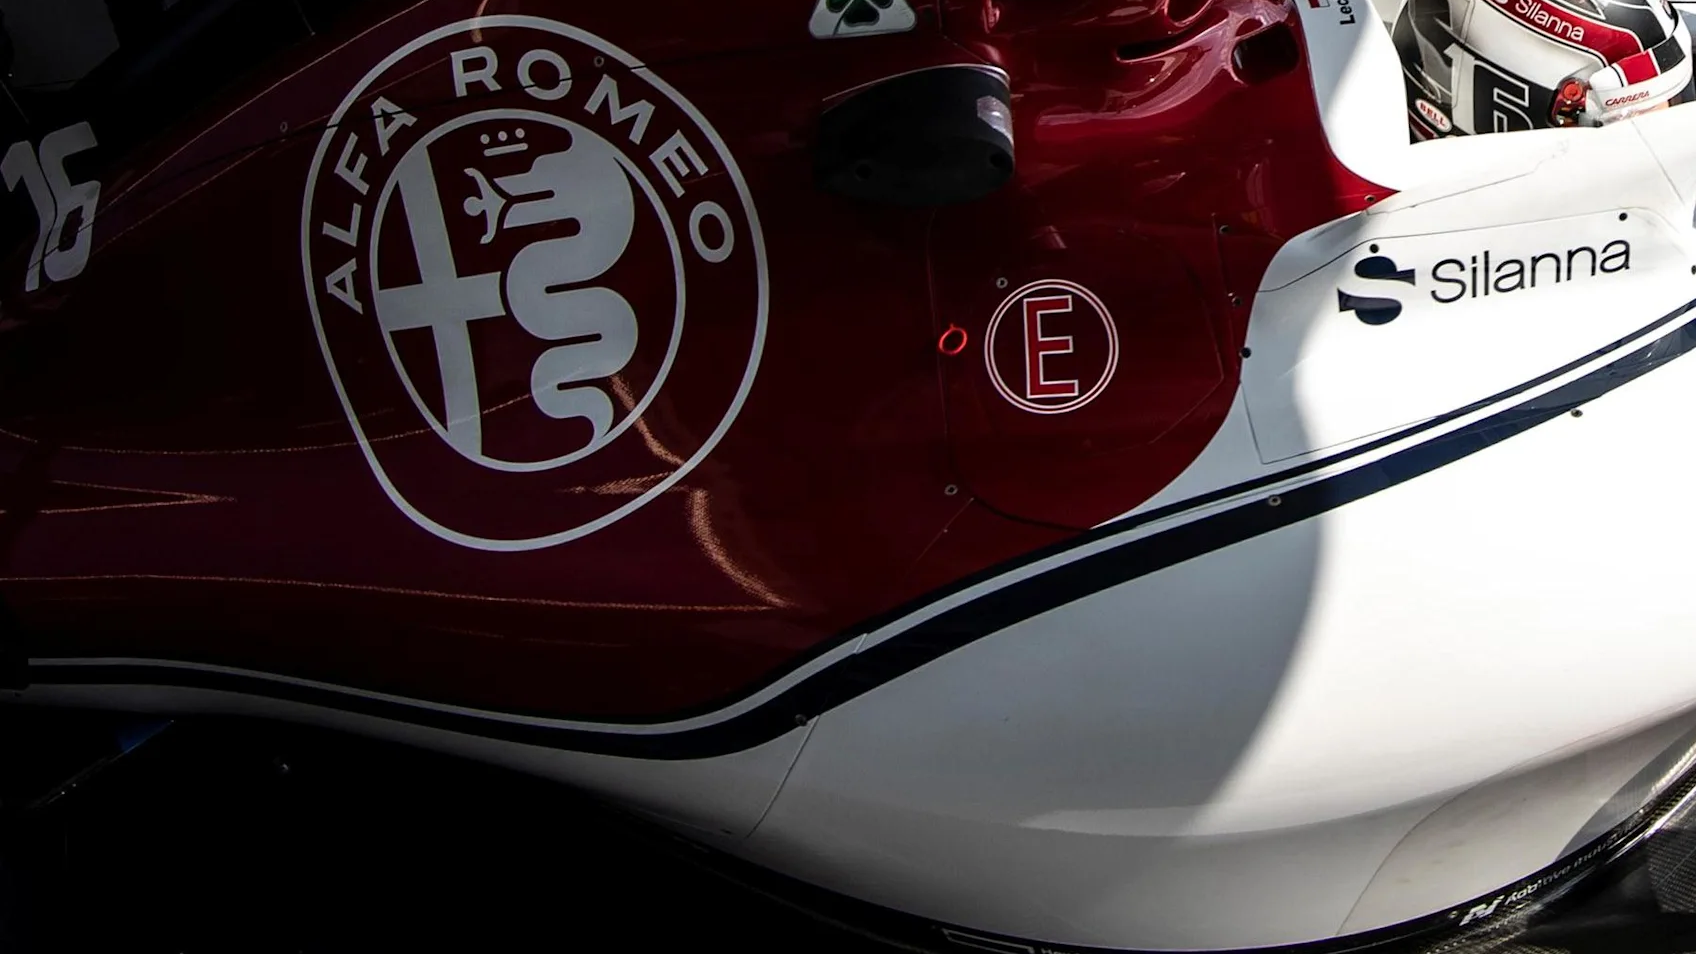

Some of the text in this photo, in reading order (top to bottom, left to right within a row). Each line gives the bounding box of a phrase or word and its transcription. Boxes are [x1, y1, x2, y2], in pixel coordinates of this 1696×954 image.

[1419, 101, 1447, 128] BELL
[1605, 90, 1650, 106] CARRERA
[0, 120, 102, 293] 16
[321, 45, 735, 315] ALFA ROMEO
[1430, 239, 1631, 305] Silanna
[1021, 294, 1080, 399] E
